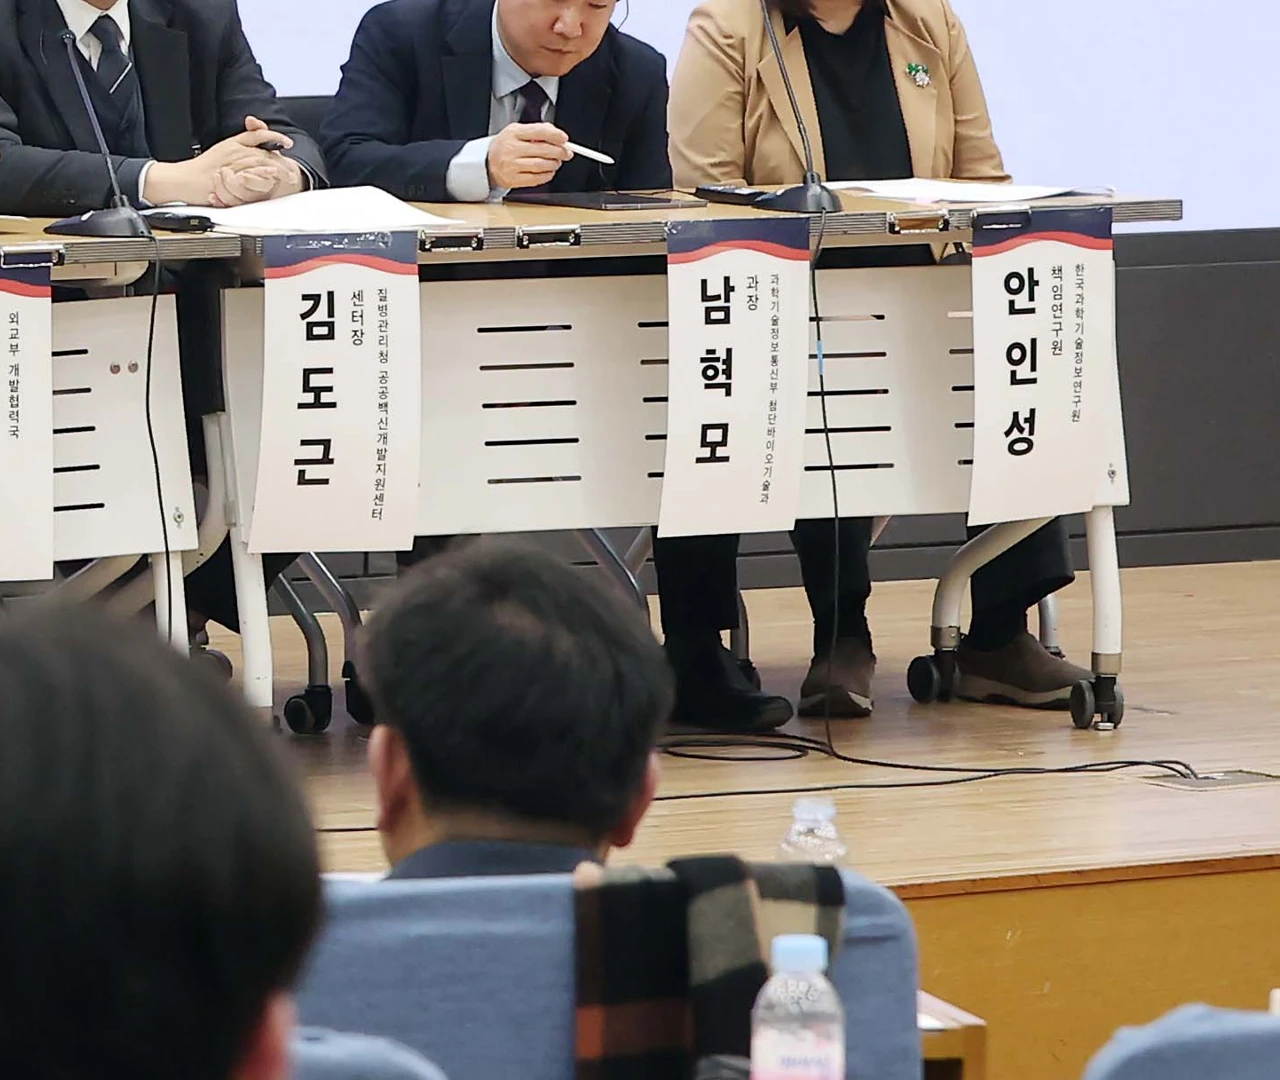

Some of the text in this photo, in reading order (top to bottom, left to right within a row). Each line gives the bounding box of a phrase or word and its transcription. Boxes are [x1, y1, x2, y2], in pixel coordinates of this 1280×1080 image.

[350, 289, 365, 346] 센터장
[746, 274, 760, 311] 과장
[1050, 265, 1064, 356] 책임연구원
[8, 311, 20, 438] 외교부 개발협력국
[371, 287, 390, 520] 질병관리청 공공백신개발지원센터
